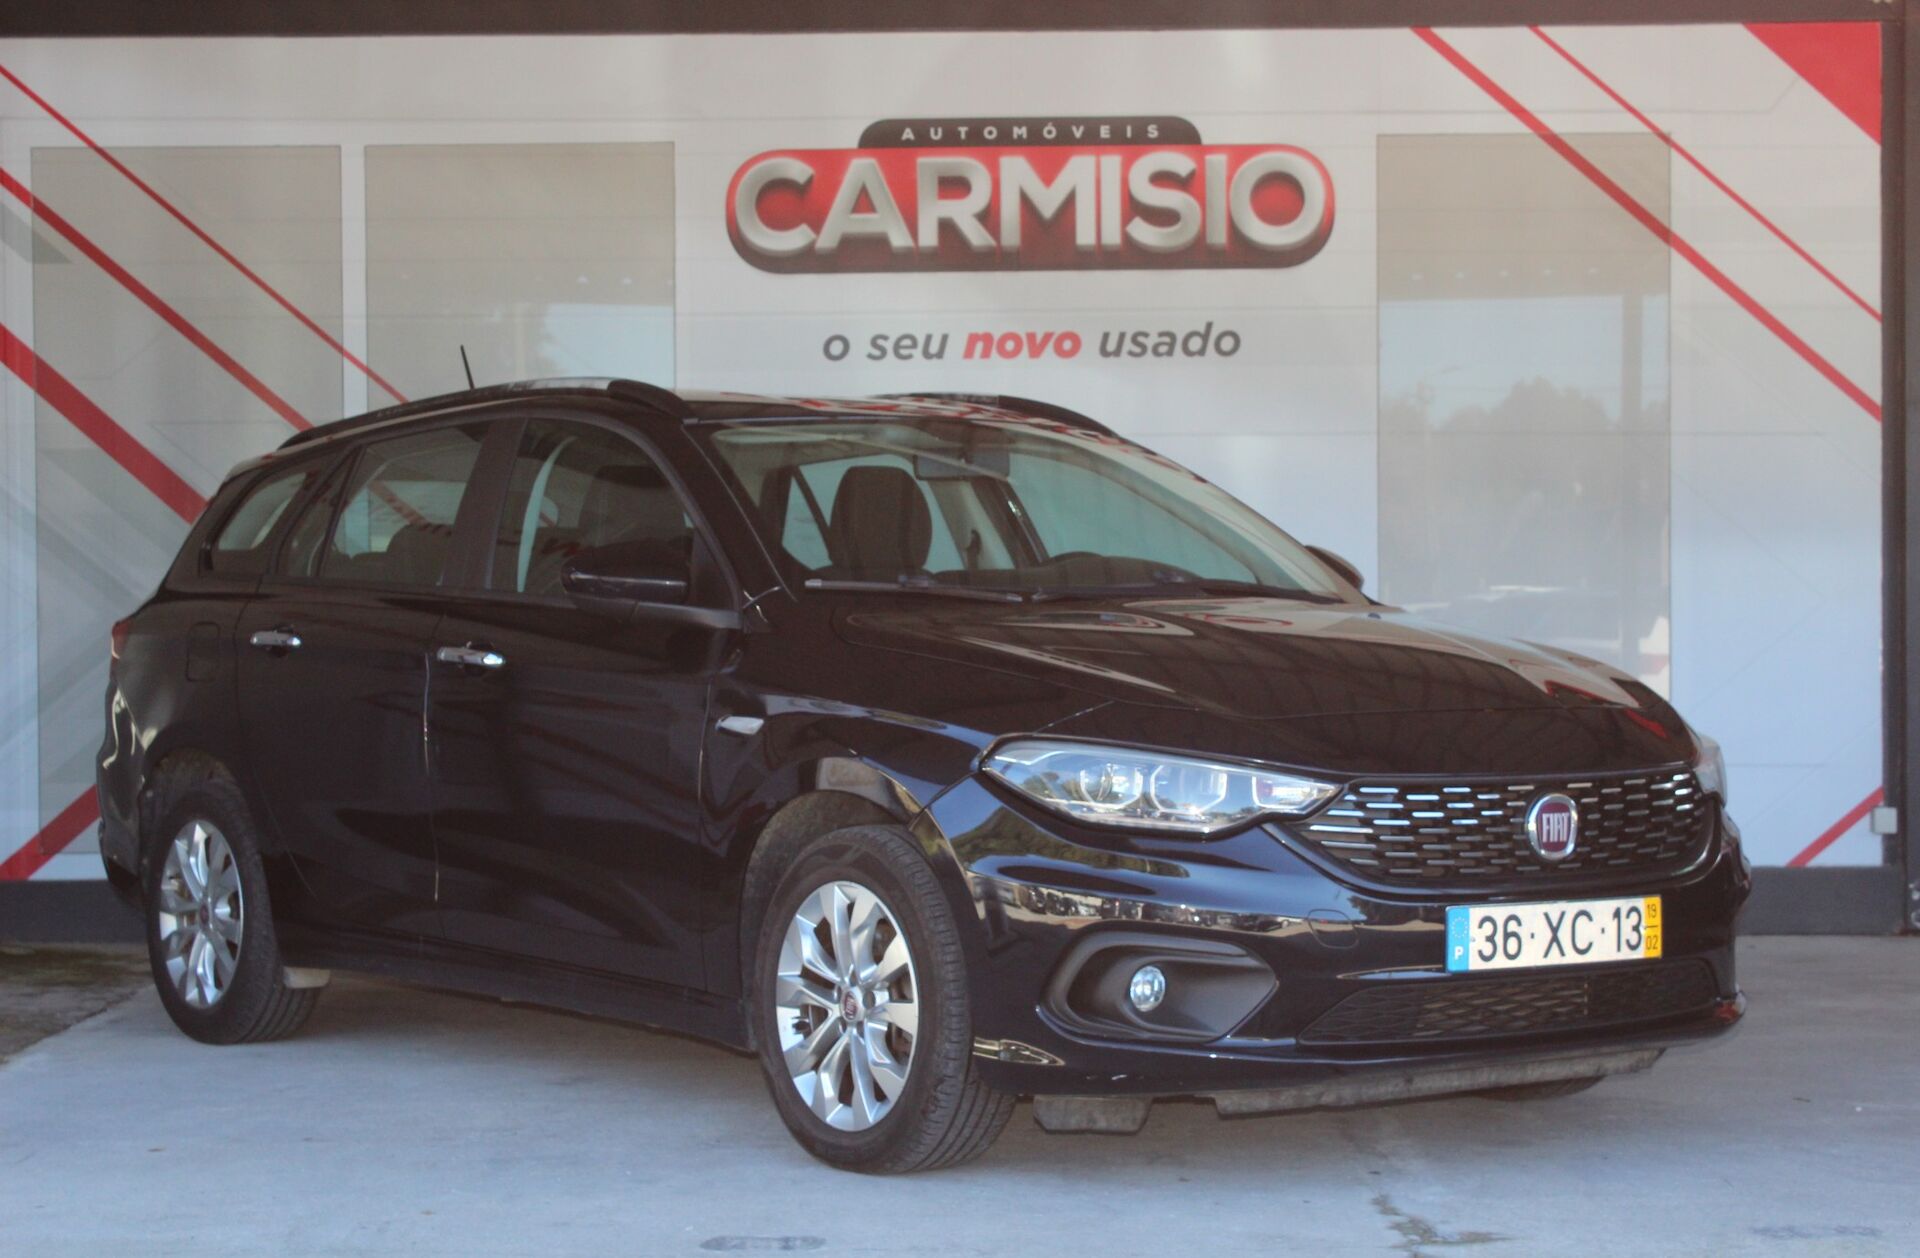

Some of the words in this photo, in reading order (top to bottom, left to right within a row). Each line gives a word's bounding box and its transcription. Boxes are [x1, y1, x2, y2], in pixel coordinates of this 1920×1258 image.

[901, 122, 1160, 141] AUTOMÓVEIS
[734, 150, 1327, 258] CARMISIO
[822, 334, 851, 361] o
[866, 332, 949, 361] seu
[962, 330, 1082, 360] novo
[1099, 322, 1242, 359] usado
[1541, 812, 1570, 843] FIAT
[1646, 903, 1657, 918] 19
[1454, 946, 1464, 960] P
[1645, 936, 1659, 951] 02
